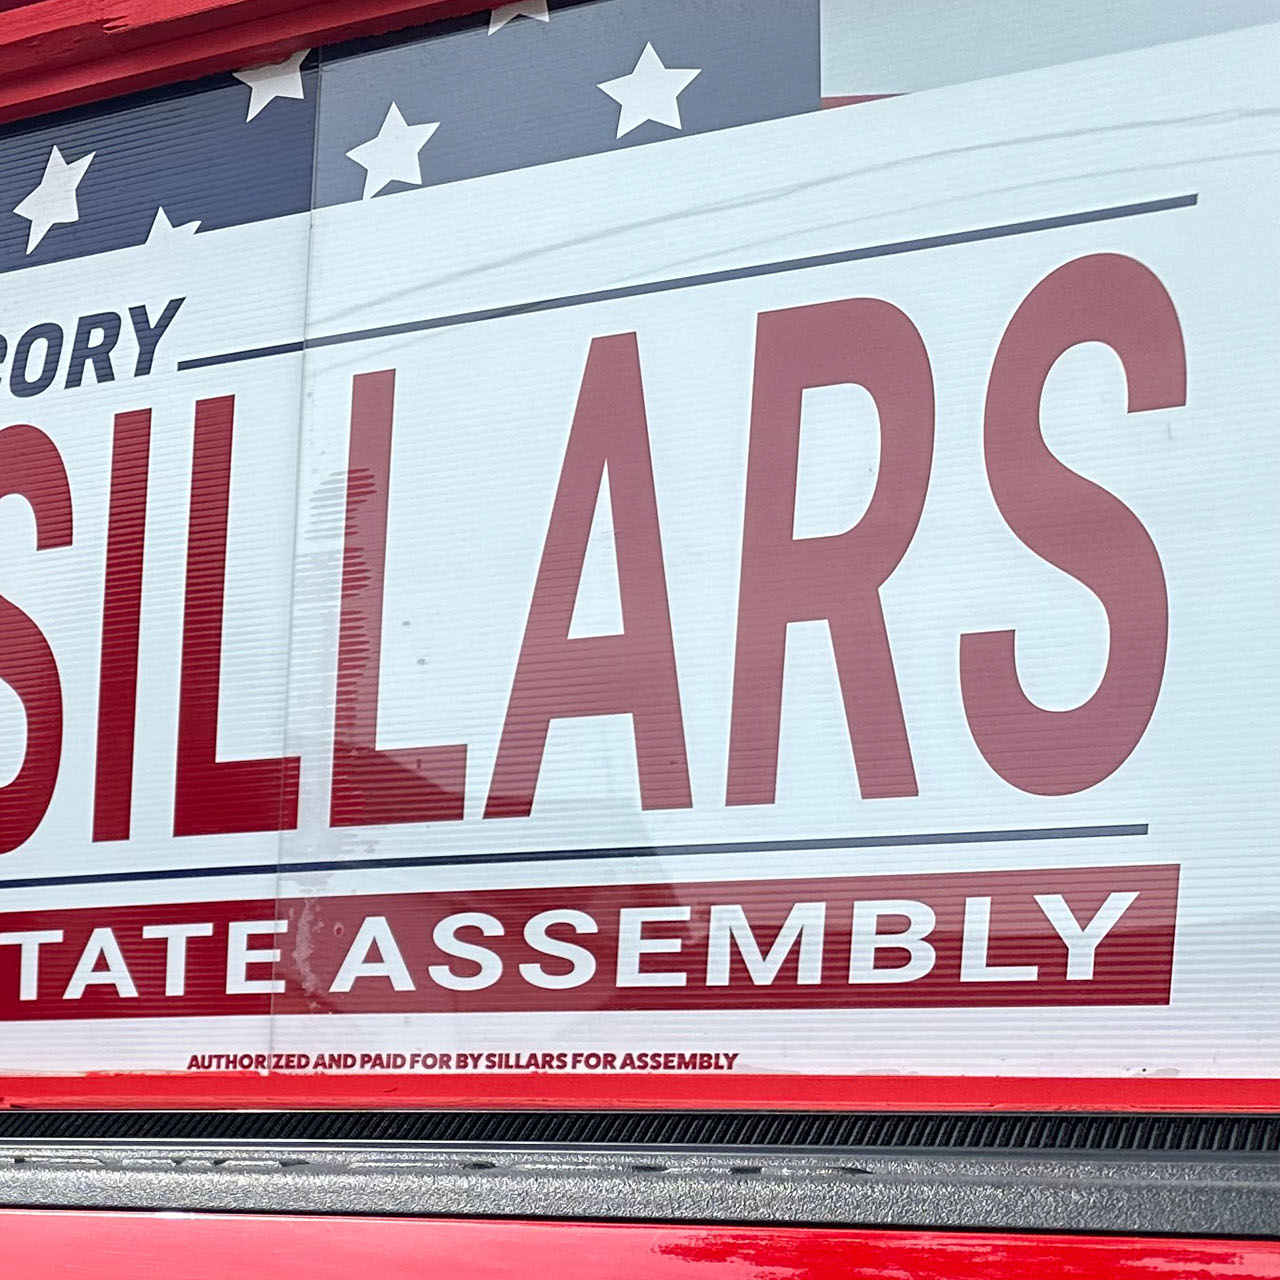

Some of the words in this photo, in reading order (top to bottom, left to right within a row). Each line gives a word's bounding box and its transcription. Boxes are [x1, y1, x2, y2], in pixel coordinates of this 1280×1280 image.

[328, 889, 1142, 993] ASSEMBLY
[186, 1052, 311, 1071] AUTHORIZED
[312, 1052, 357, 1071] AND
[359, 1052, 407, 1071] PAID
[409, 1052, 451, 1071] FOR
[455, 1052, 483, 1071] BY
[484, 1052, 568, 1071] SILLARS
[571, 1052, 616, 1071] FOR
[619, 1052, 740, 1071] ASSEMBLY
